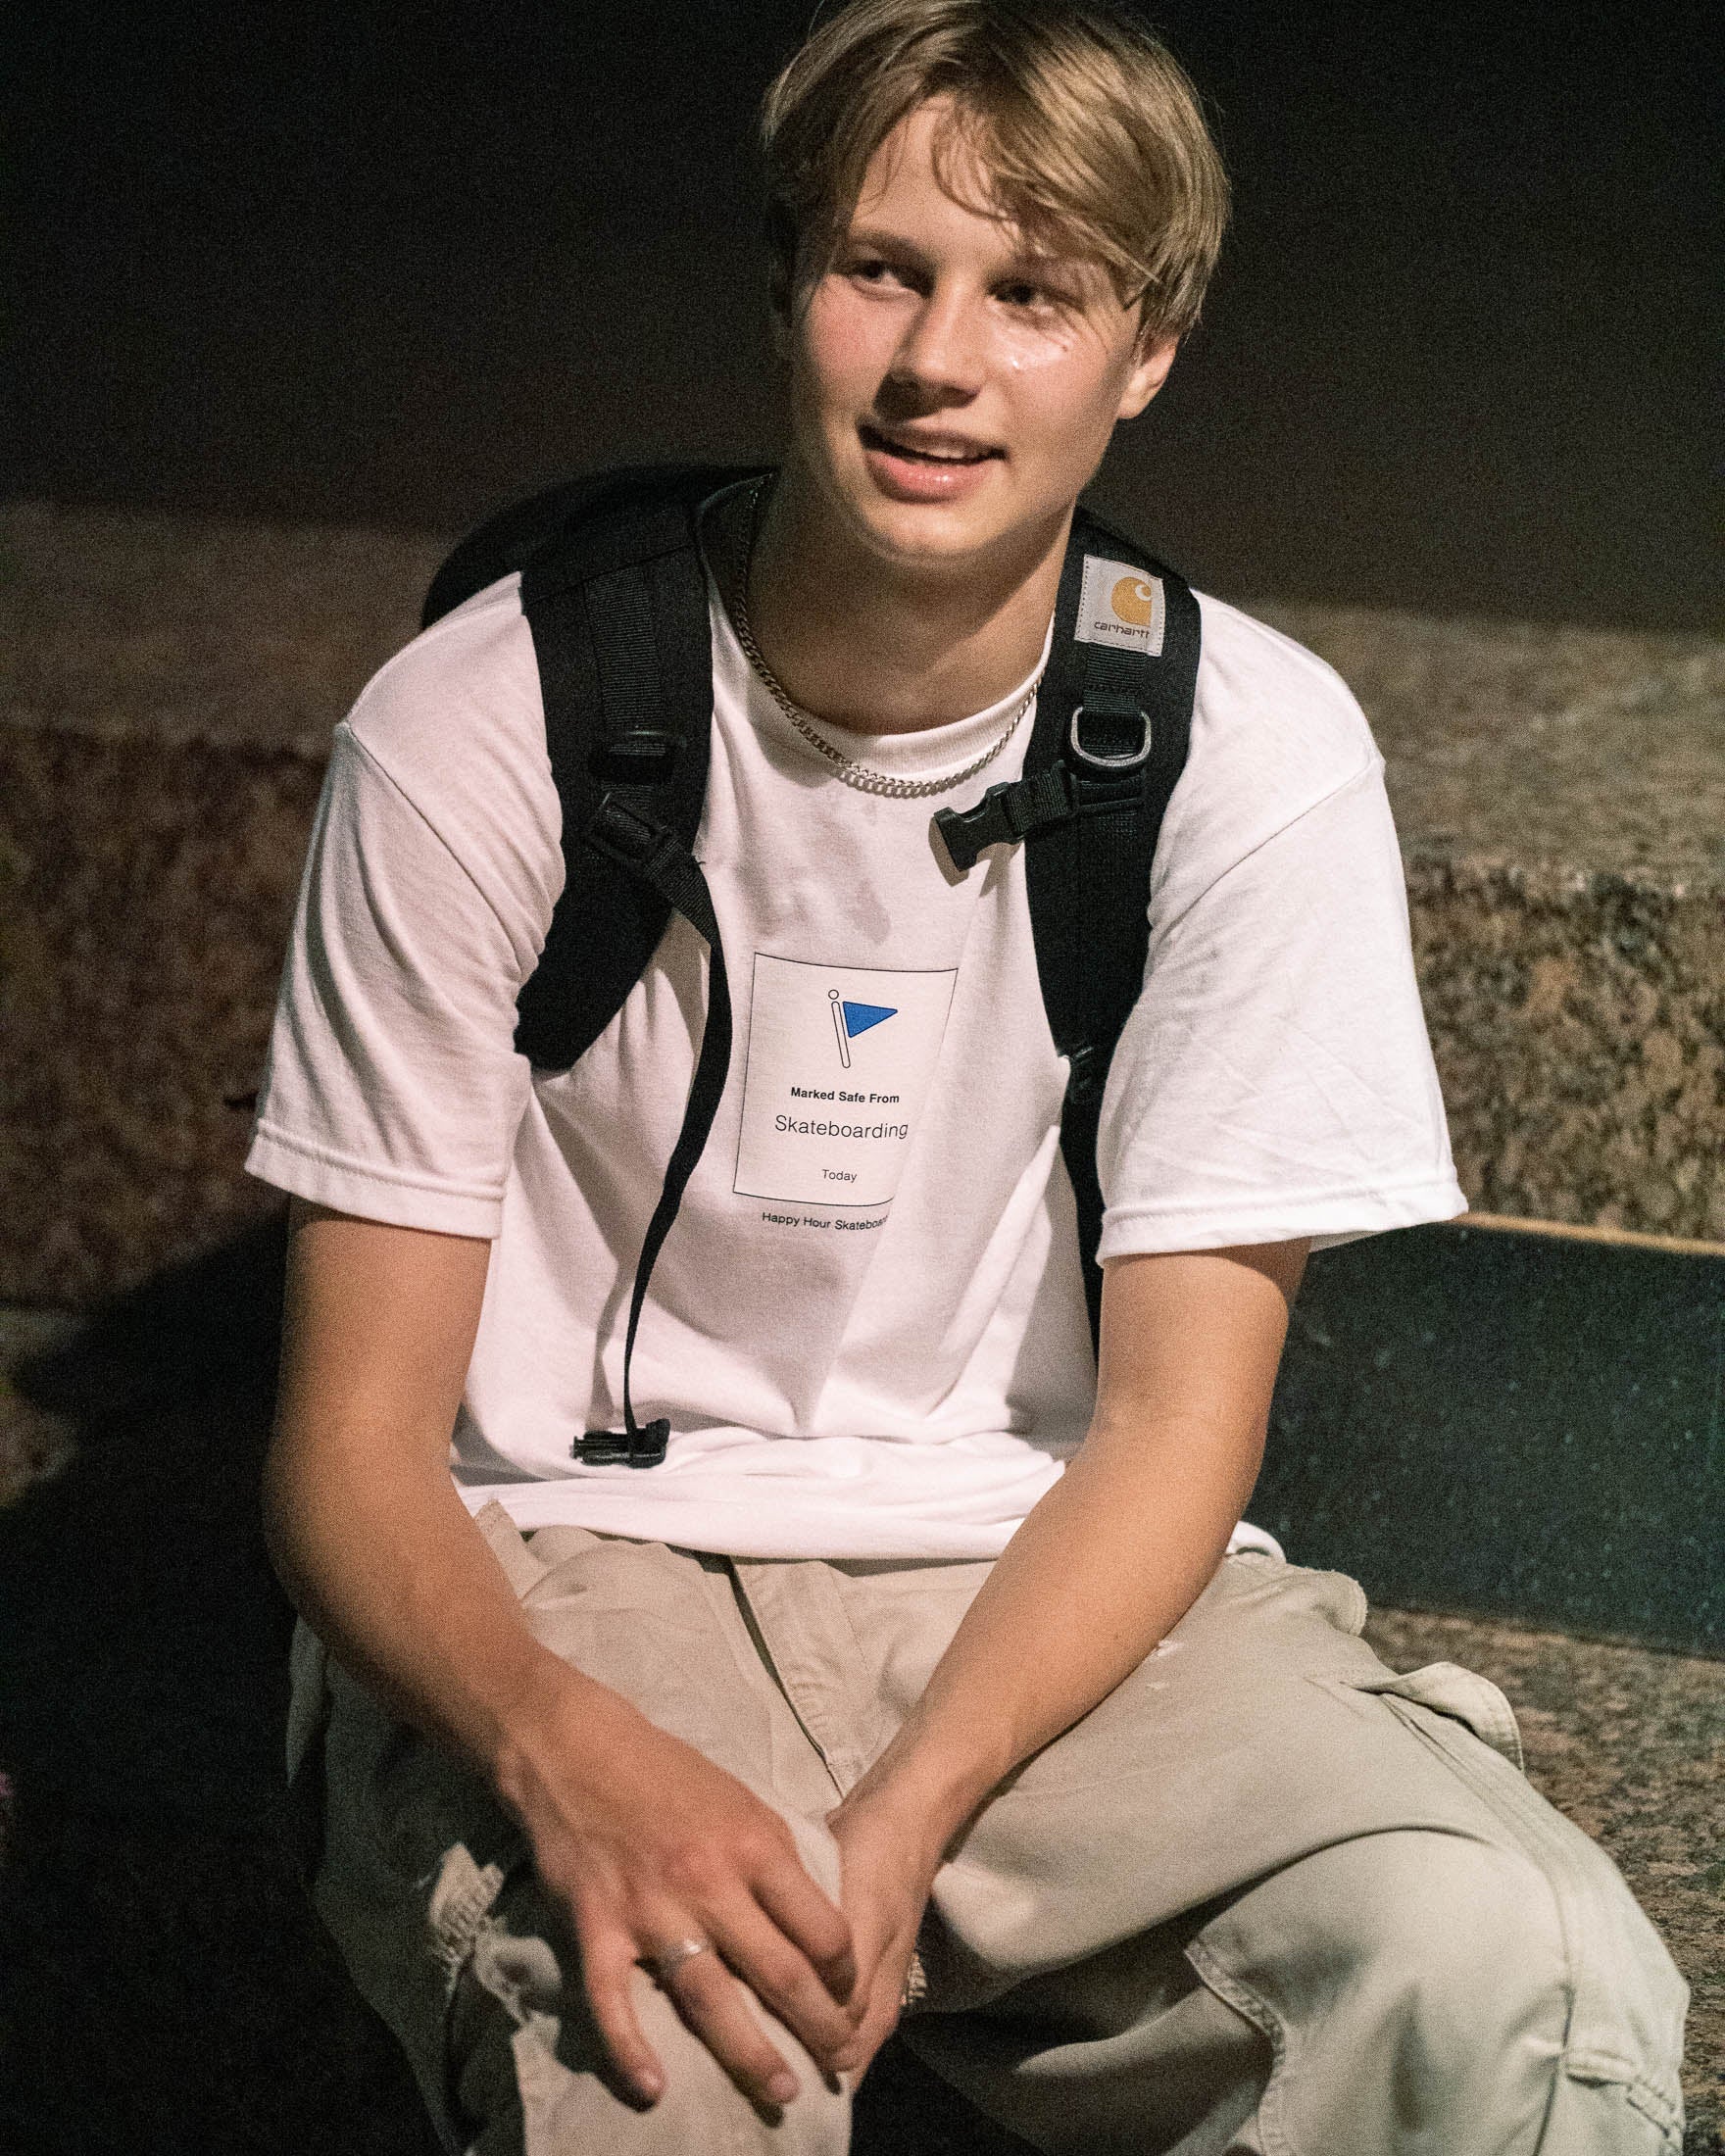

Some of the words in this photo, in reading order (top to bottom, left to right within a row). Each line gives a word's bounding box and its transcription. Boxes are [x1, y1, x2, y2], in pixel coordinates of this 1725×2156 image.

[1094, 621, 1151, 639] carhartt
[791, 1087, 835, 1101] Marked
[838, 1091, 865, 1102] Safe
[869, 1094, 900, 1103] From
[775, 1115, 909, 1140] Skateboarding
[822, 1169, 858, 1183] Today
[762, 1211, 800, 1227] Happy
[803, 1217, 831, 1228] Hour
